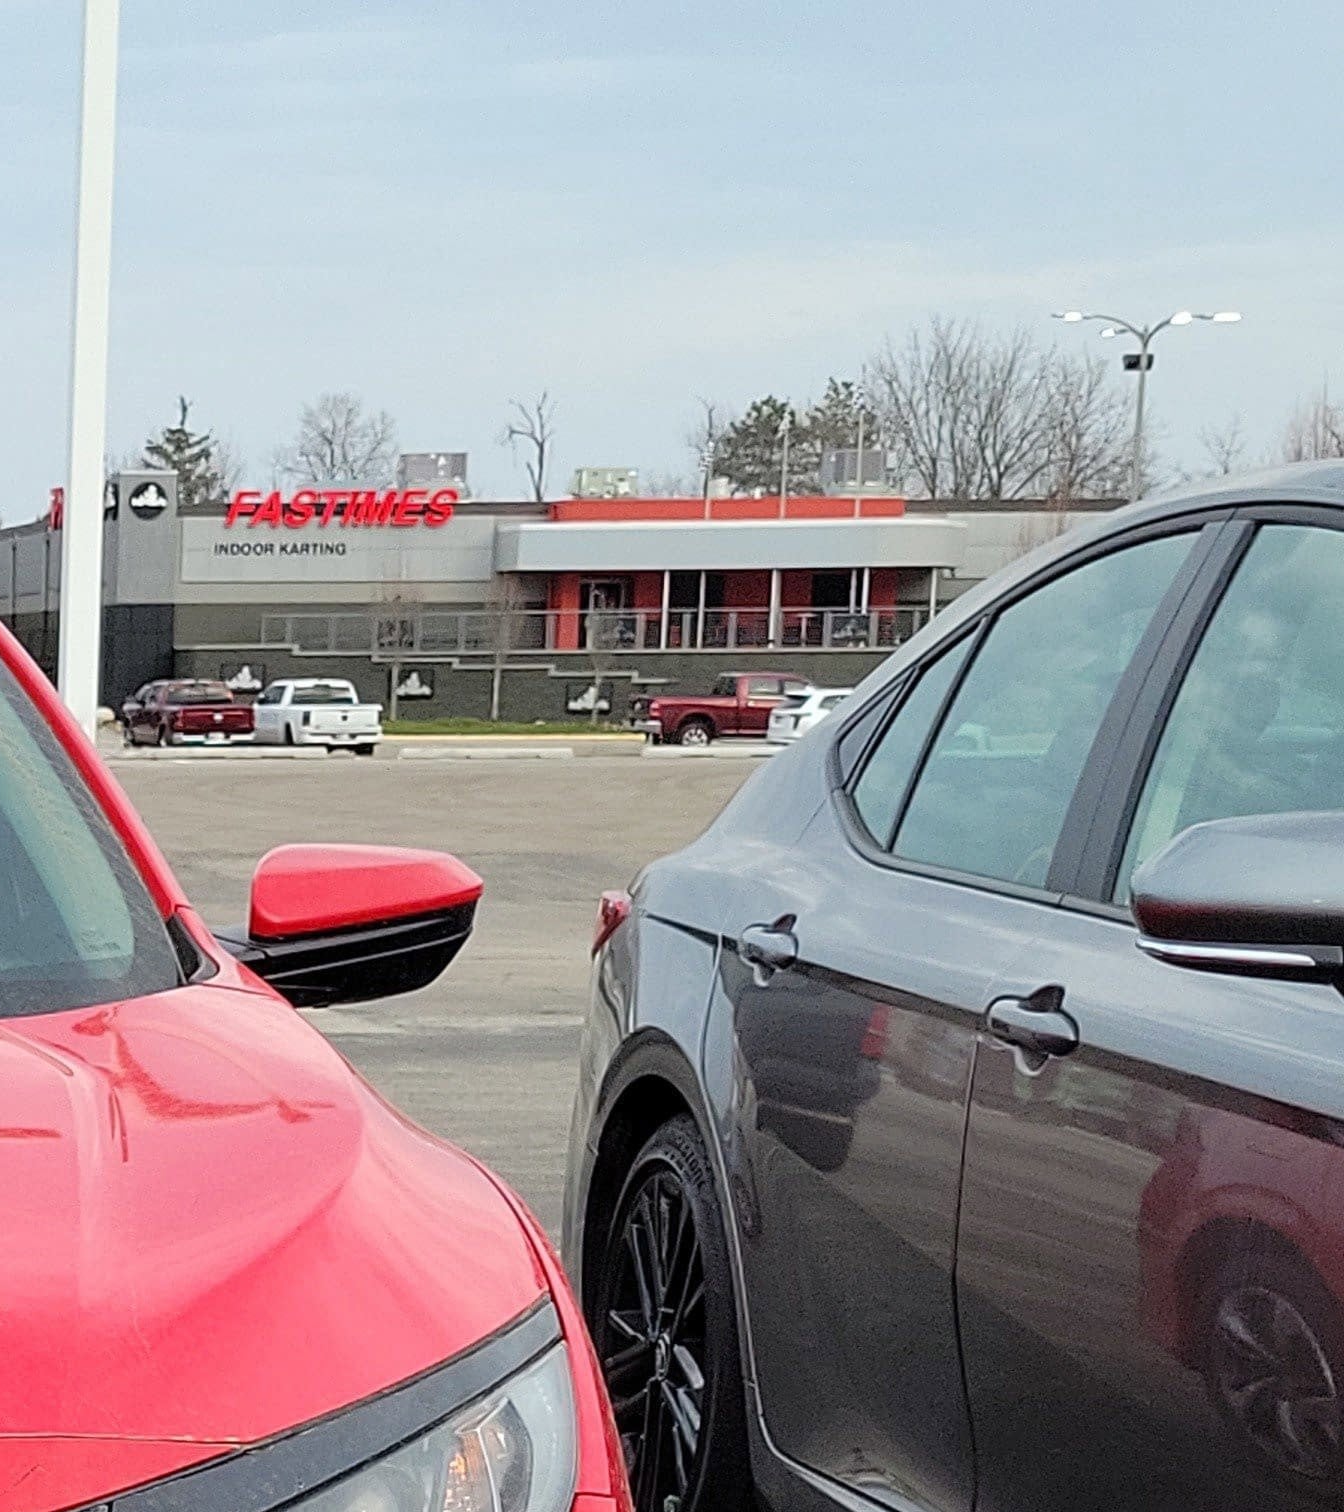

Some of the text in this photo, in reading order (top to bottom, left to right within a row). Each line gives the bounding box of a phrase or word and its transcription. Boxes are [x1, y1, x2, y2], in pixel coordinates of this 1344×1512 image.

[224, 488, 459, 529] FASTIMES
[214, 542, 347, 556] INDOOR KARTING
